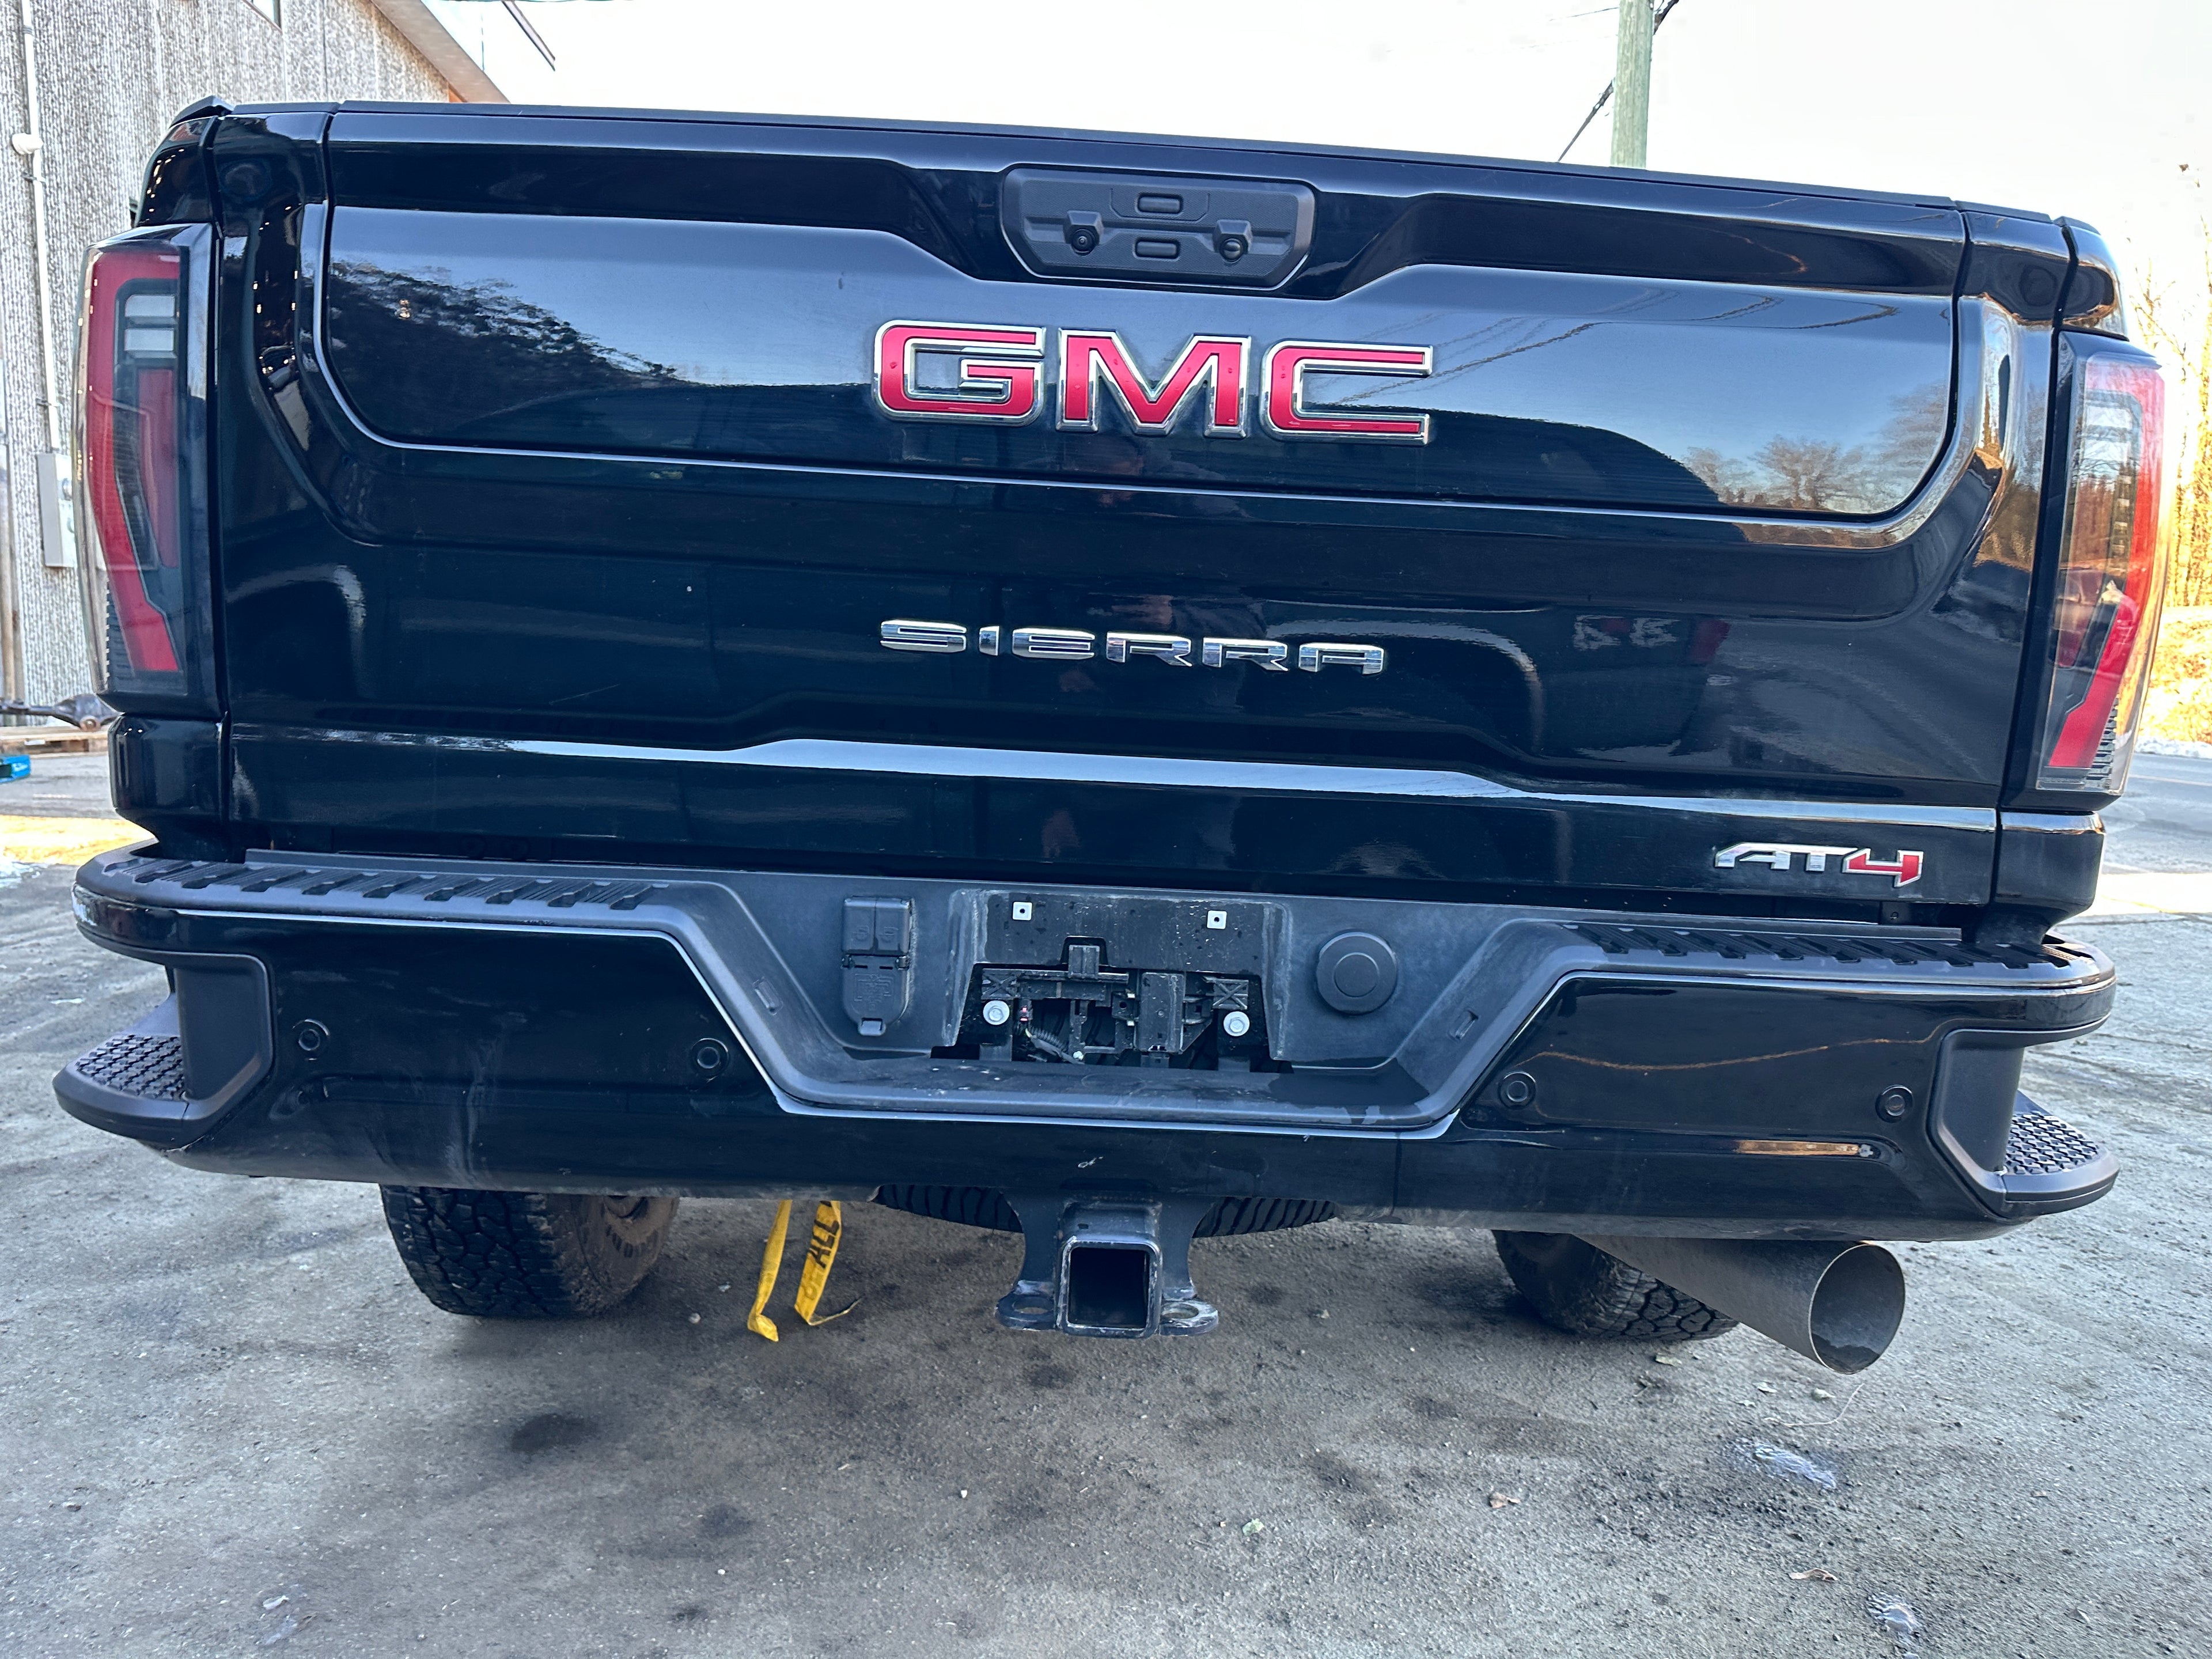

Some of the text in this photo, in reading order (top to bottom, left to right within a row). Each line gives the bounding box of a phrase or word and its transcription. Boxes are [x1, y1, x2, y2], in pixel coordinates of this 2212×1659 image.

[874, 320, 1433, 445] GMC
[880, 619, 1384, 675] SIERRA
[1714, 842, 1924, 888] AT4
